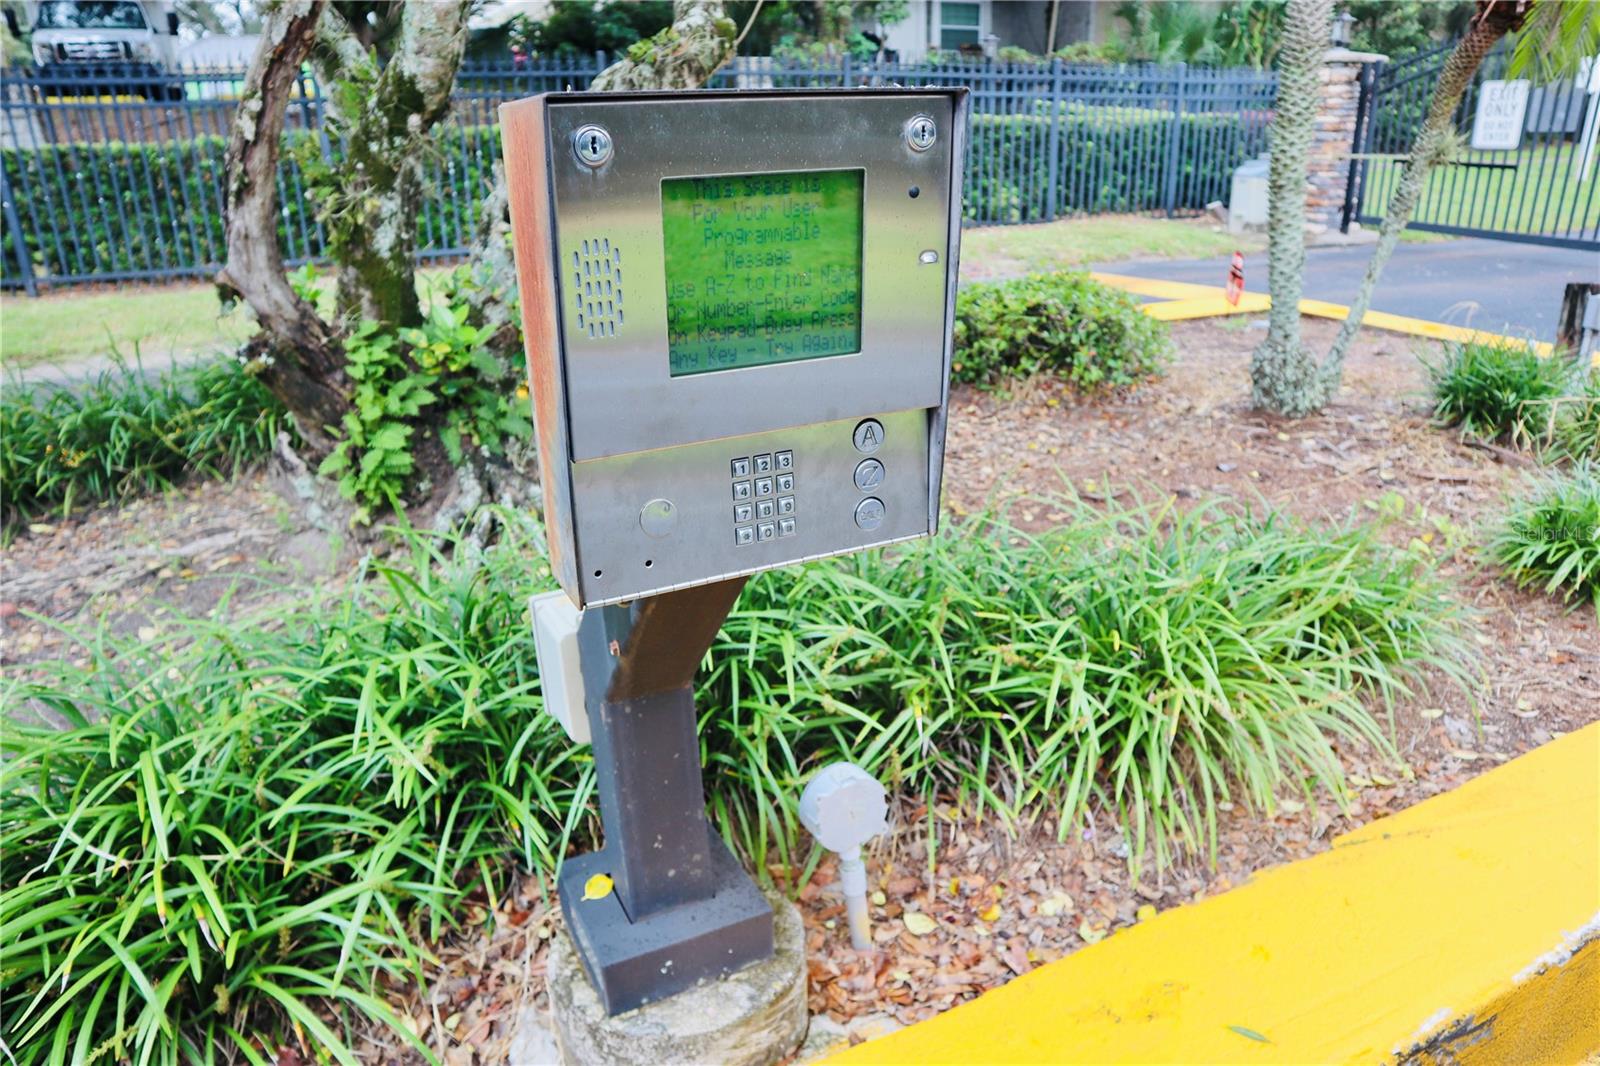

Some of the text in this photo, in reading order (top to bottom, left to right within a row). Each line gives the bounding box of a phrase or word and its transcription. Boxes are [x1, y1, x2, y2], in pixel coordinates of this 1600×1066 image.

[1489, 86, 1519, 101] EXIT
[1485, 102, 1518, 117] ONLY
[693, 177, 735, 200] This
[743, 175, 792, 197] Space
[692, 197, 821, 224] For Your User
[704, 221, 821, 248] Programmable
[723, 250, 792, 271] Message
[705, 273, 736, 297] A-Z
[744, 272, 765, 292] to
[774, 267, 812, 289] Find
[667, 303, 687, 324] Or
[821, 287, 857, 308] Code
[811, 310, 855, 329] Press
[669, 349, 699, 369] Any
[708, 345, 738, 366] Key
[765, 338, 793, 357] Try
[861, 425, 880, 446] A
[761, 461, 768, 471] 2
[782, 457, 790, 467] 3
[862, 465, 879, 487] Z
[740, 480, 791, 497] 4 5 6
[742, 502, 792, 520] 7 8 9
[764, 528, 772, 538] 0
